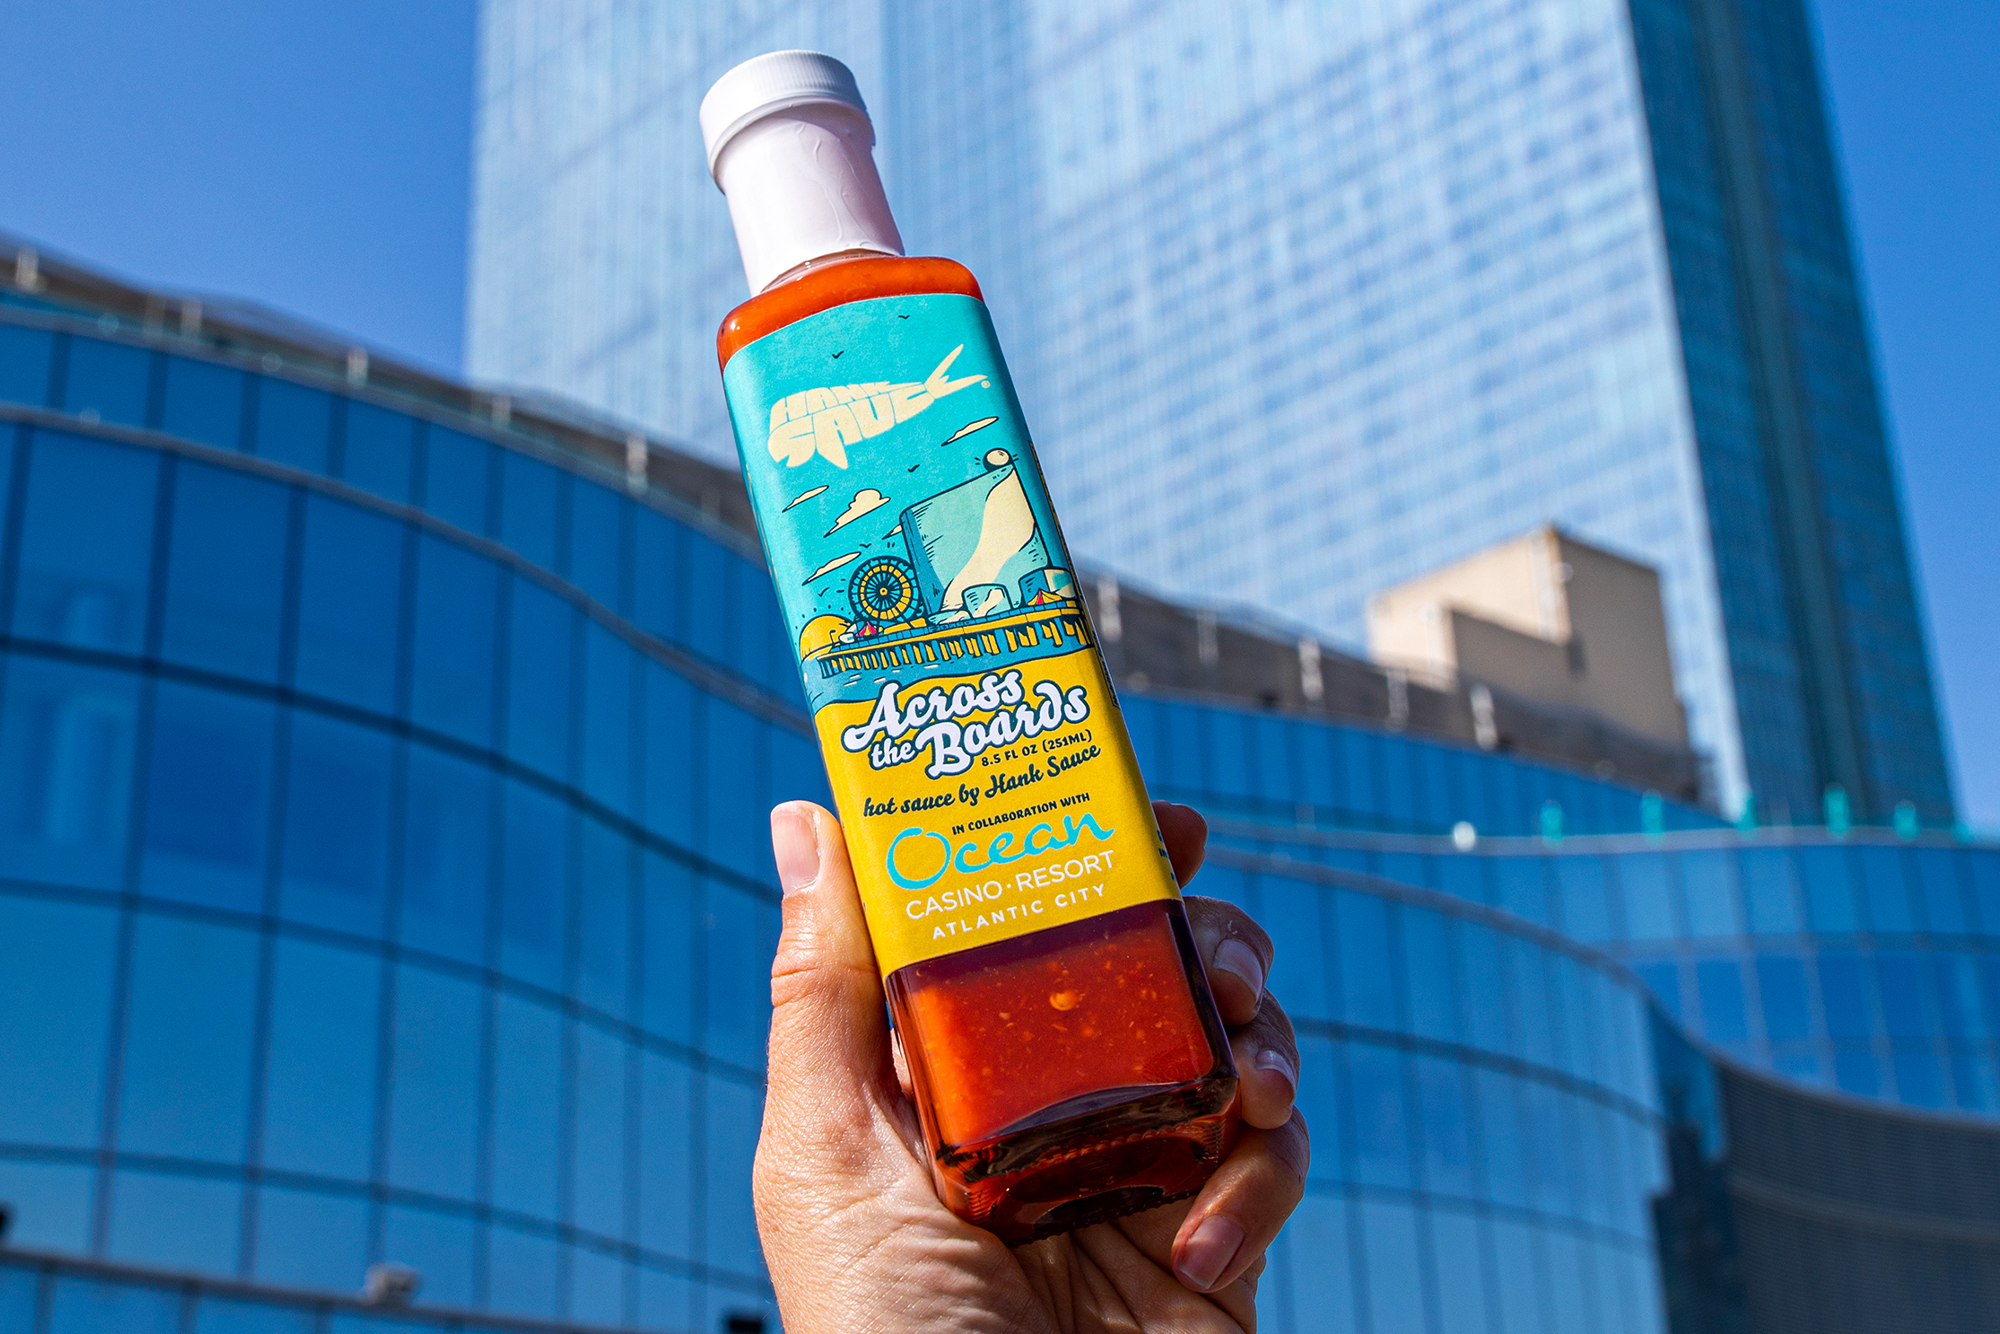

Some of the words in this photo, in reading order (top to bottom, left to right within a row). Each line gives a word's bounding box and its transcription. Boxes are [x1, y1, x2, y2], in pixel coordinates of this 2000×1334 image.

[769, 381, 922, 434] HANK
[842, 669, 1025, 752] Across
[868, 735, 917, 770] the
[914, 680, 1090, 779] Boards
[981, 755, 1001, 768] 8.5
[1005, 748, 1019, 761] FL
[1021, 743, 1039, 758] OZ
[1042, 728, 1092, 753] (251ML)
[863, 797, 898, 818] hot
[900, 792, 955, 812] sauce
[959, 784, 980, 806] by
[984, 764, 1044, 798] Hank
[1046, 744, 1101, 777] Sauce
[952, 824, 965, 836] IN
[968, 800, 1057, 832] COLLABORATION
[1060, 792, 1091, 808] WITH
[886, 812, 1115, 890] Ocean
[932, 900, 1044, 940] ATLANTIC
[1055, 883, 1106, 908] CITY
